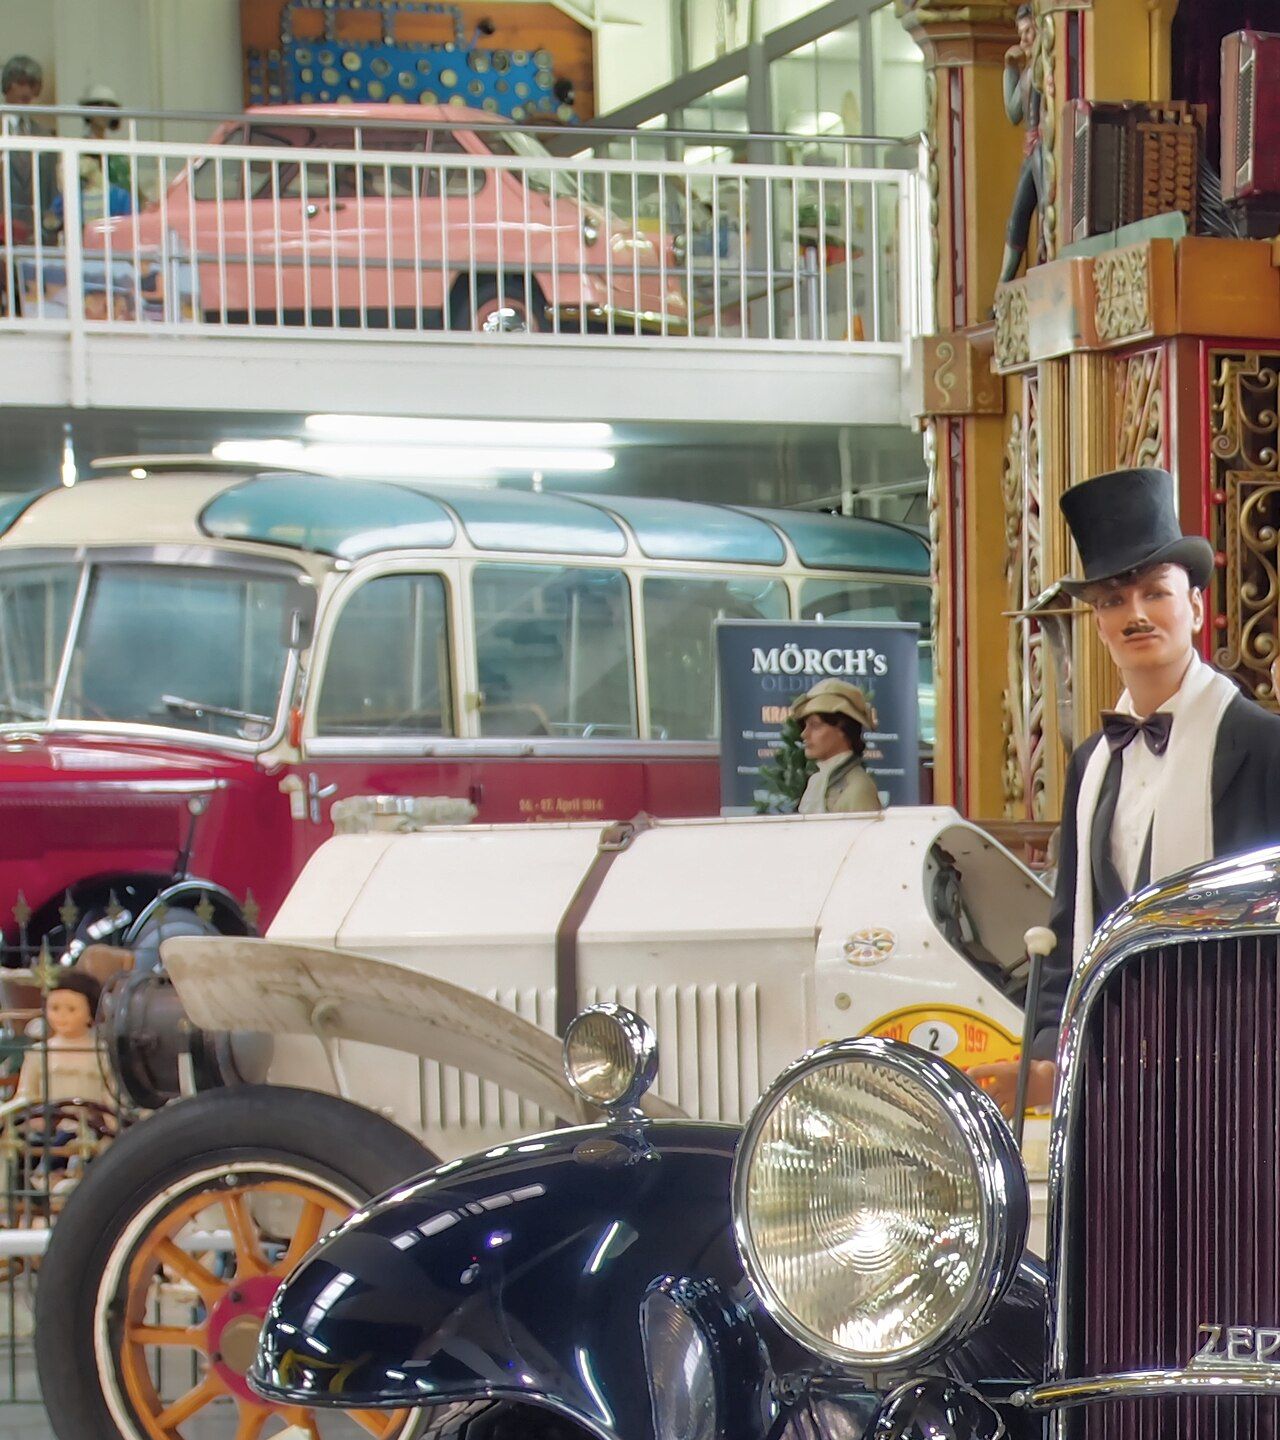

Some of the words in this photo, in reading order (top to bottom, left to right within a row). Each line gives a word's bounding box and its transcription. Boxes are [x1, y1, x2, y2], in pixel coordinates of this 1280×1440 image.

[752, 643, 888, 676] MÖRCH's
[928, 1028, 939, 1051] 2
[964, 1020, 988, 1053] 1997
